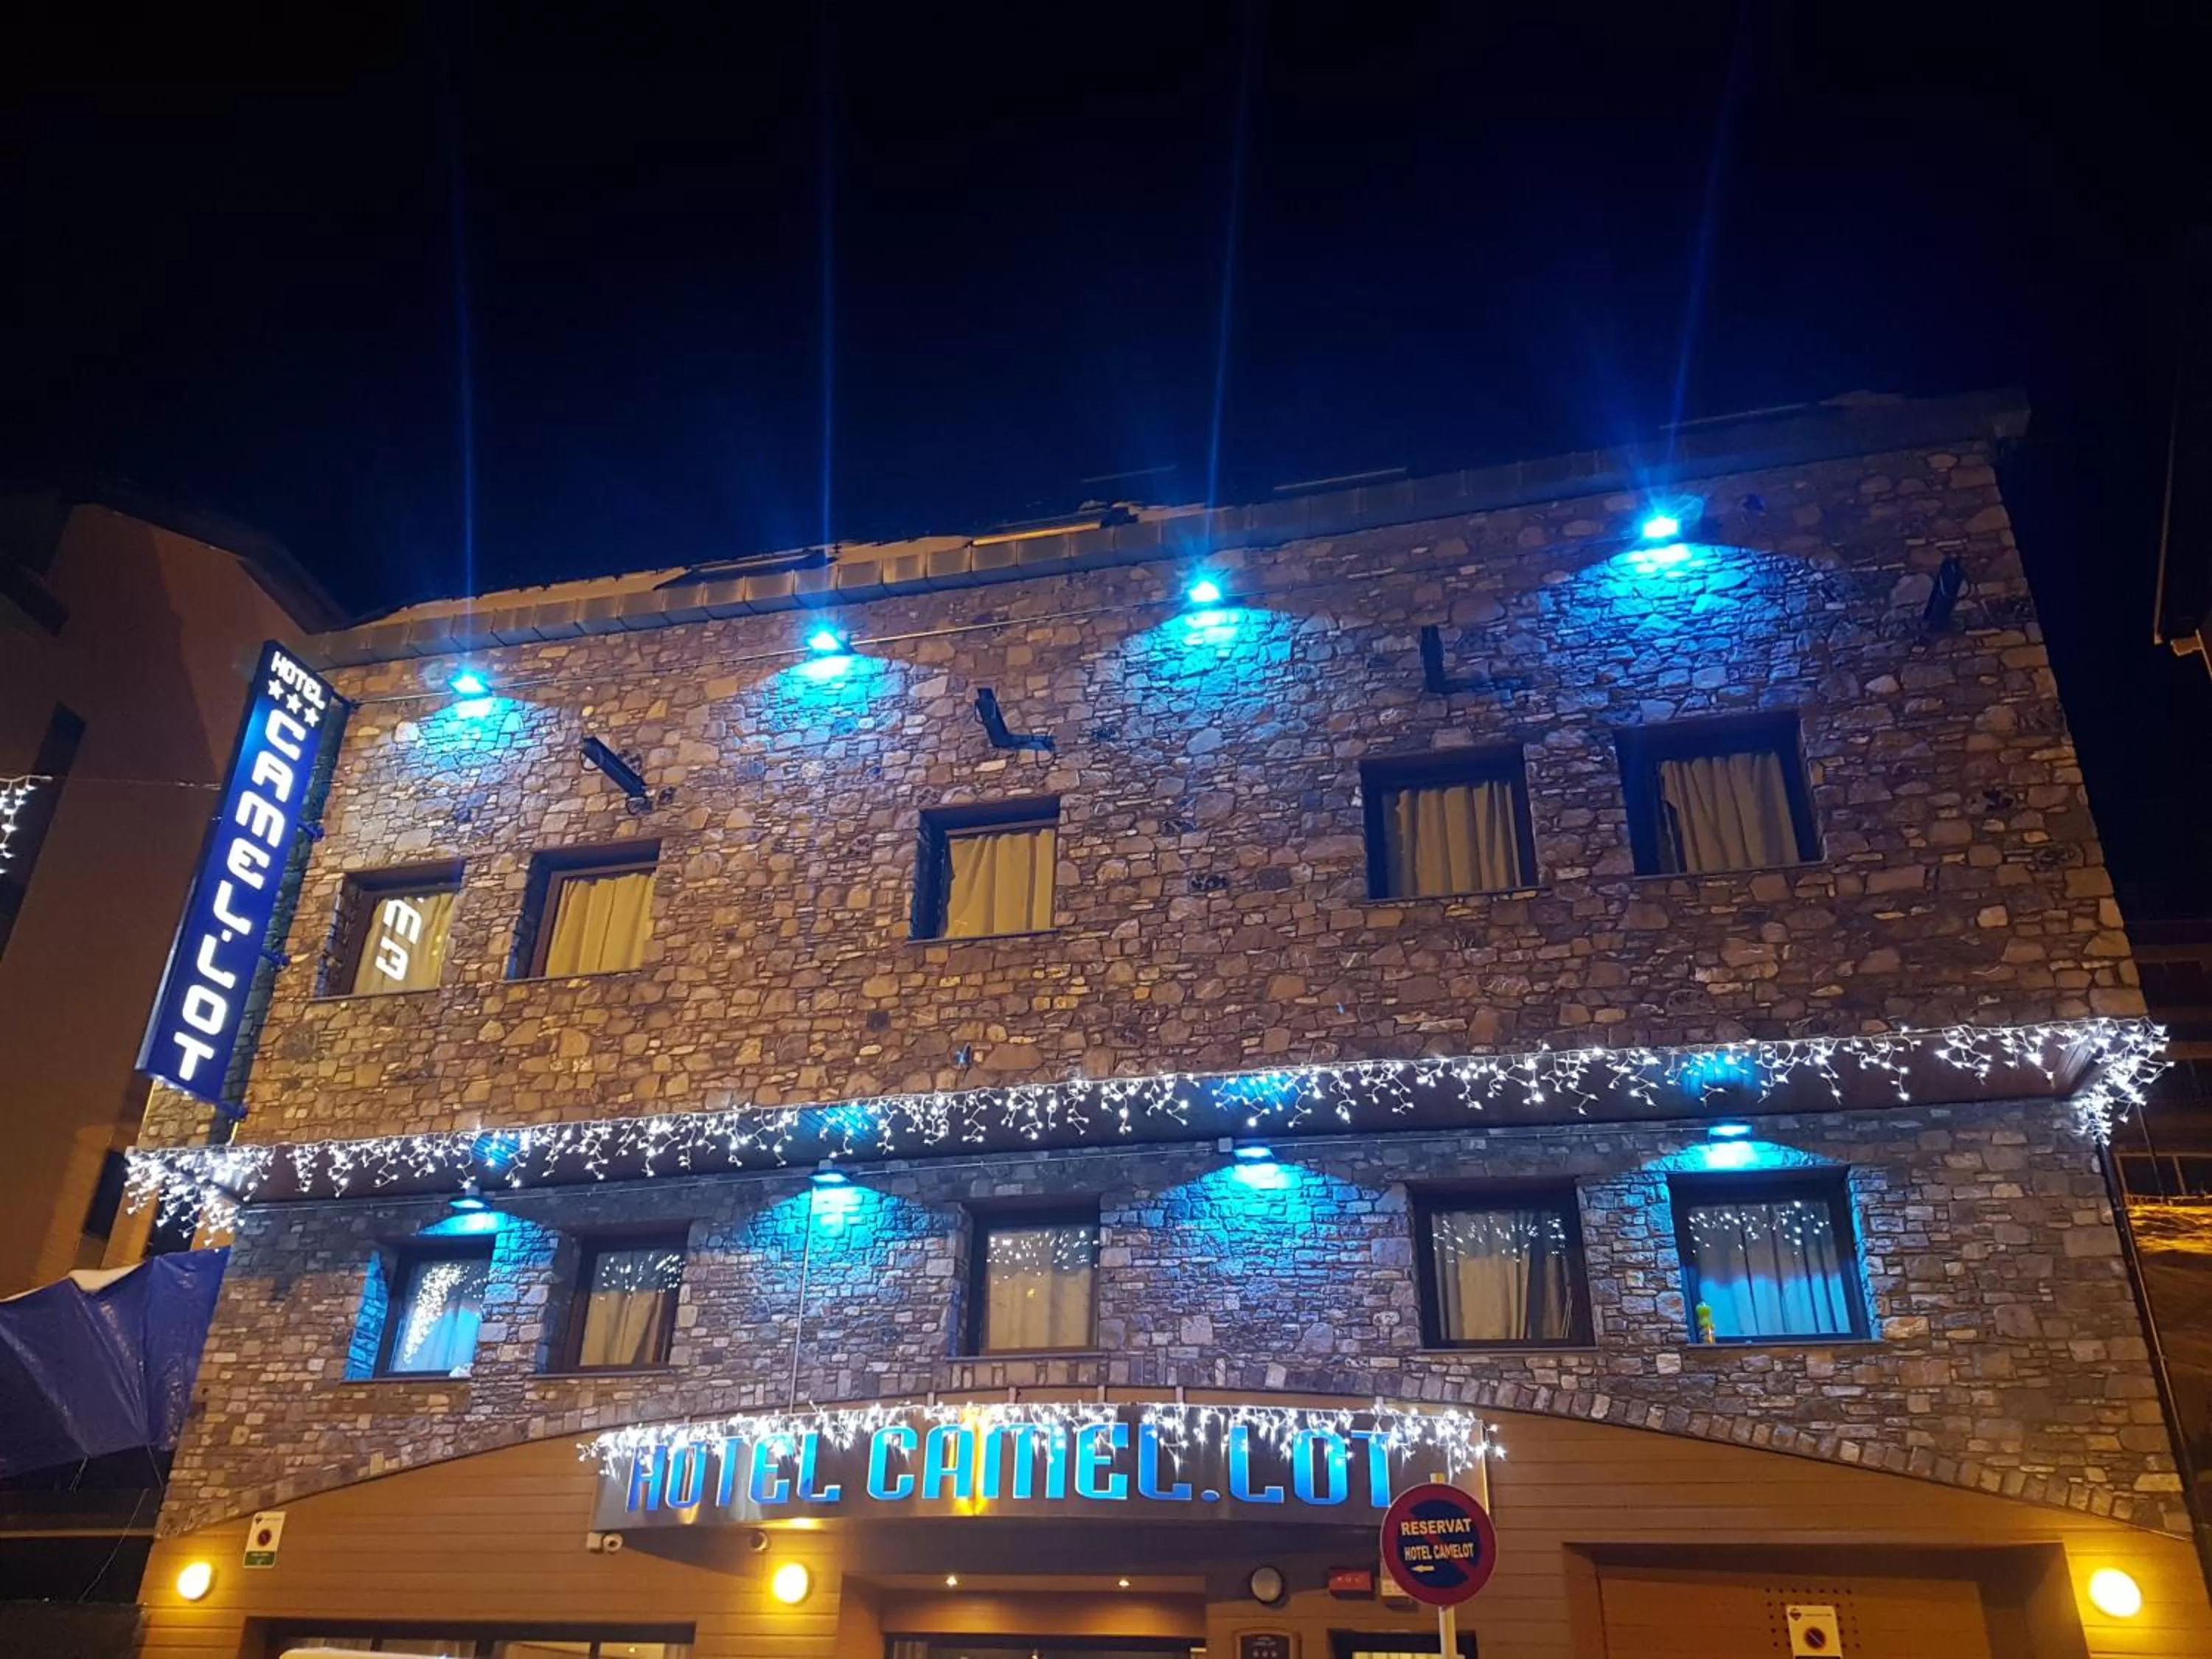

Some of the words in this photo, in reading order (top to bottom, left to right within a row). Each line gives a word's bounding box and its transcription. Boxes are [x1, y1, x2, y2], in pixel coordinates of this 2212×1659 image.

[271, 650, 326, 710] HOTEL
[625, 1429, 841, 1512] HOTEL
[1401, 1518, 1472, 1536] RESERVAT
[1404, 1545, 1433, 1561] HOTEL
[1433, 1543, 1474, 1559] CAMELOT
